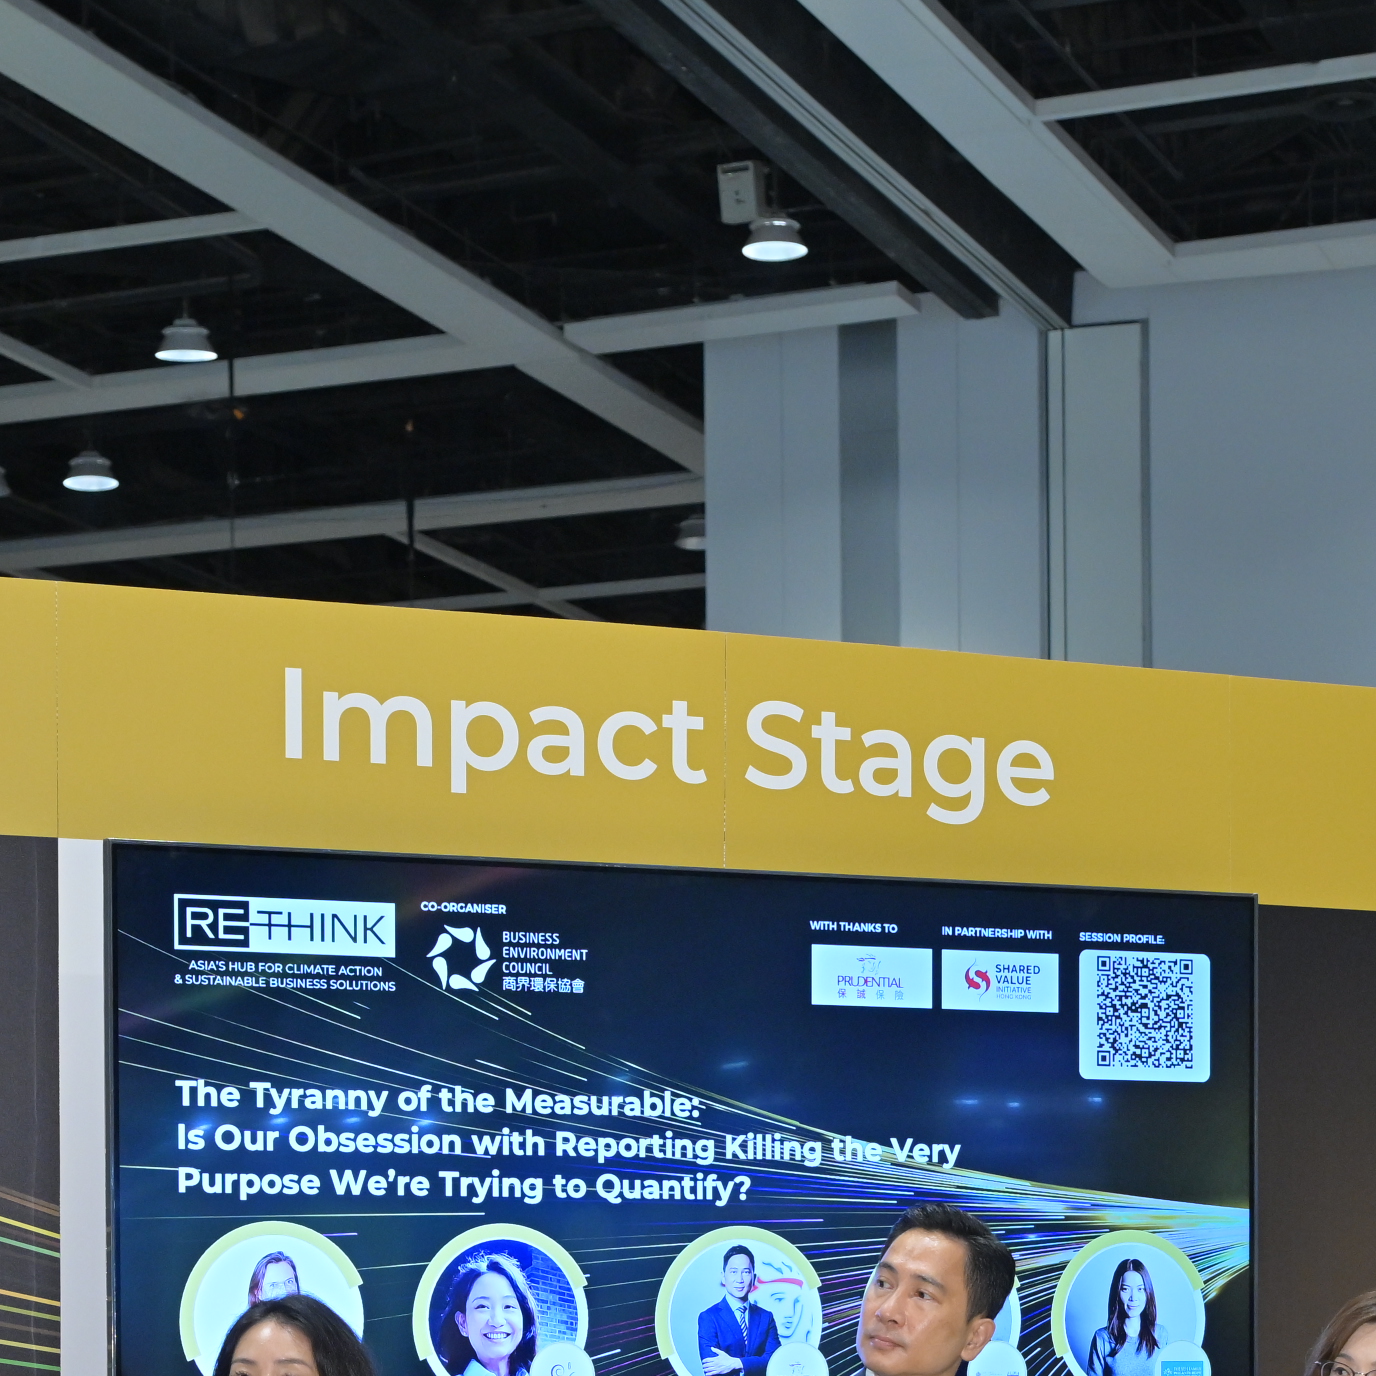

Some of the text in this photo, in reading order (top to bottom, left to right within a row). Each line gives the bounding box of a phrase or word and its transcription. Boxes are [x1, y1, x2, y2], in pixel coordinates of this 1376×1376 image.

[284, 667, 1055, 825] Impact Stage
[420, 901, 507, 914] CO-ORGANISER
[809, 920, 898, 933] WITH THANKS TO
[941, 926, 1052, 940] IN PARTNERSHIP WITH
[502, 931, 560, 944] BUSINESS
[1079, 932, 1165, 944] SESSION PROFILE:
[502, 947, 588, 961] ENVIRONMENT
[189, 960, 382, 977] ASIA'S HUB FOR CLIMATE ACTION
[502, 962, 553, 974] COUNCIL
[995, 964, 1041, 975] SHARED
[174, 974, 396, 992] & SUSTAINABLE BUSINESS SOLUTIONS
[502, 977, 585, 993] 商界環保協會
[837, 975, 904, 988] PRUDENTIAL
[995, 975, 1031, 985] VALUE
[175, 1079, 700, 1118] The Tyranny of the Measurable:
[177, 1124, 961, 1170] Is Our Obsession with Reporting Killing the Very
[177, 1166, 751, 1207] Purpose We’re Trying to Quantify?
